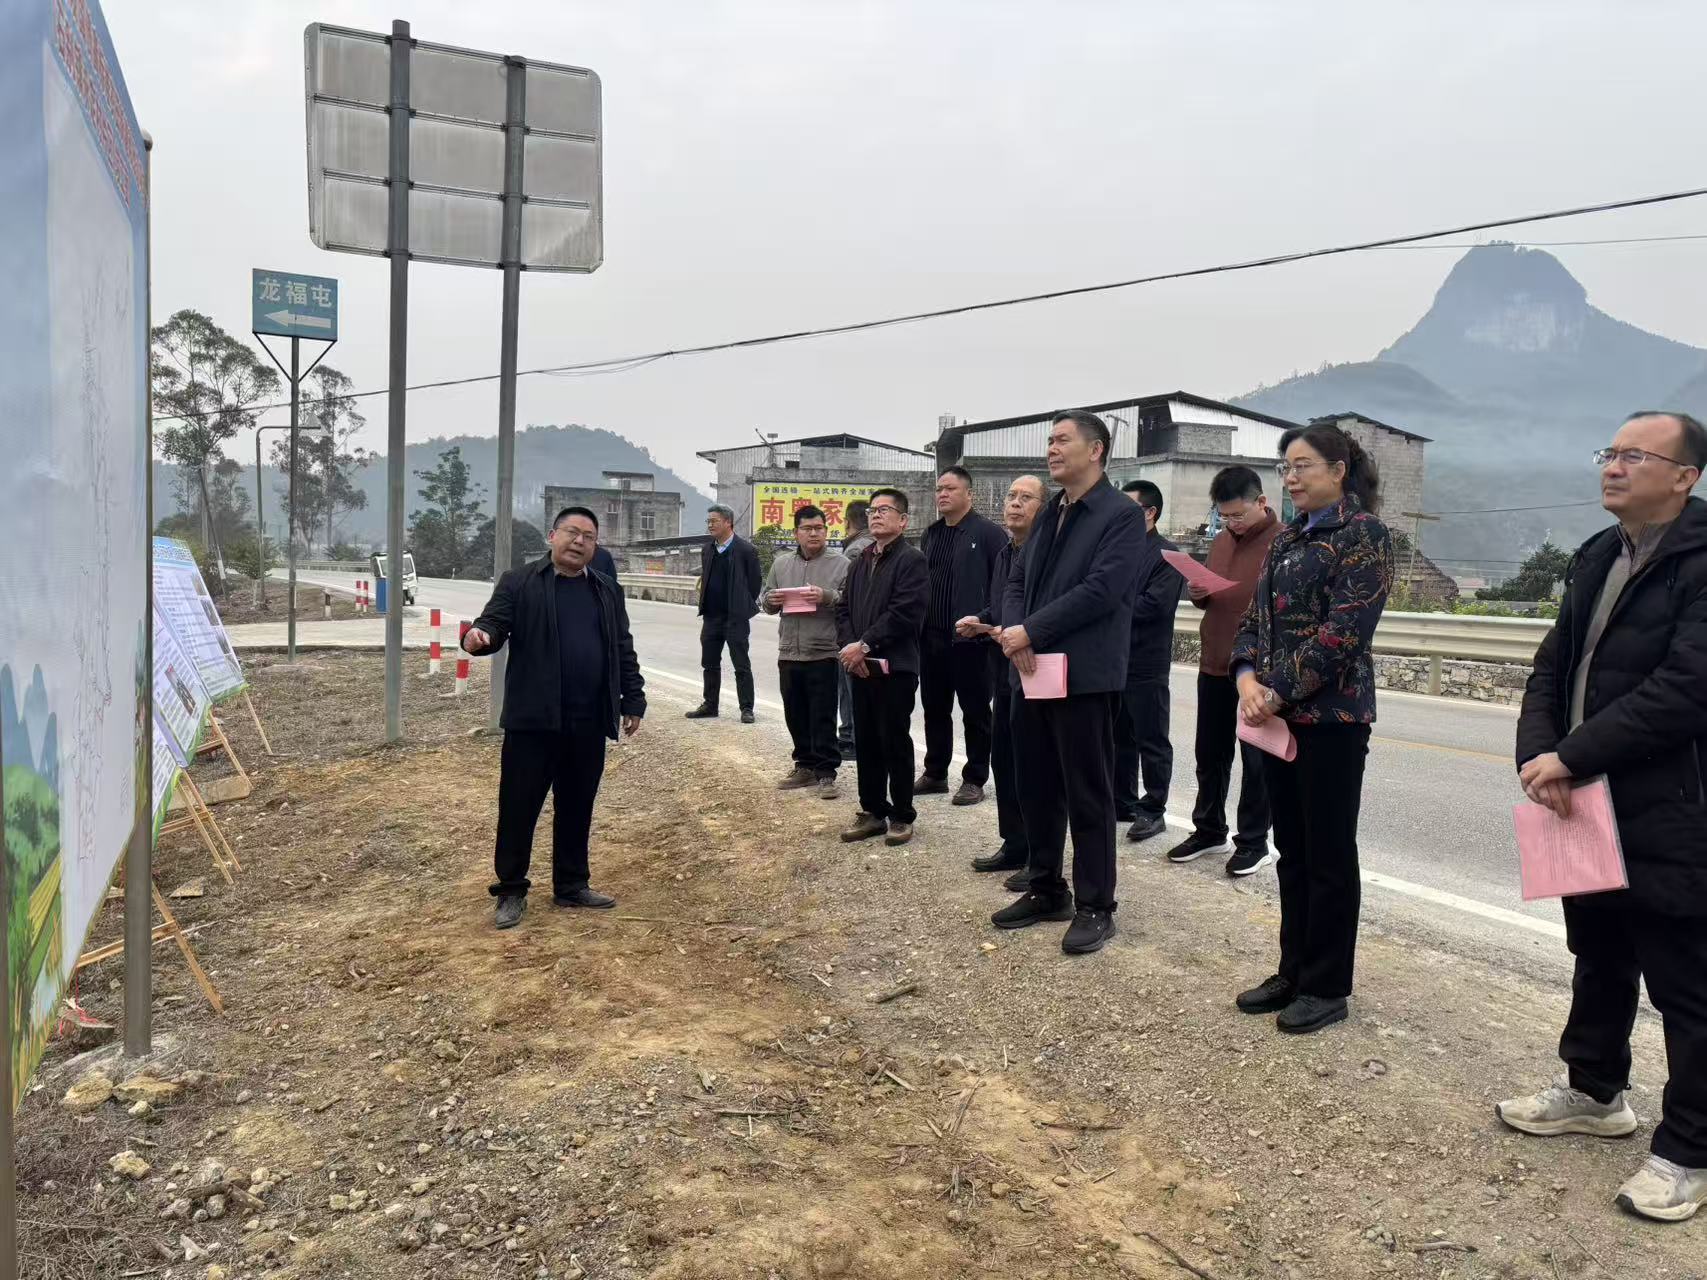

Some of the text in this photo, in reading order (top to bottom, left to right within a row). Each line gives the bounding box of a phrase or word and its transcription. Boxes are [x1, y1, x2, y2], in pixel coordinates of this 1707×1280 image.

[258, 277, 332, 308] 龙福屯
[803, 487, 880, 496] 一站式购齐全屋家
[759, 497, 871, 526] 南家
